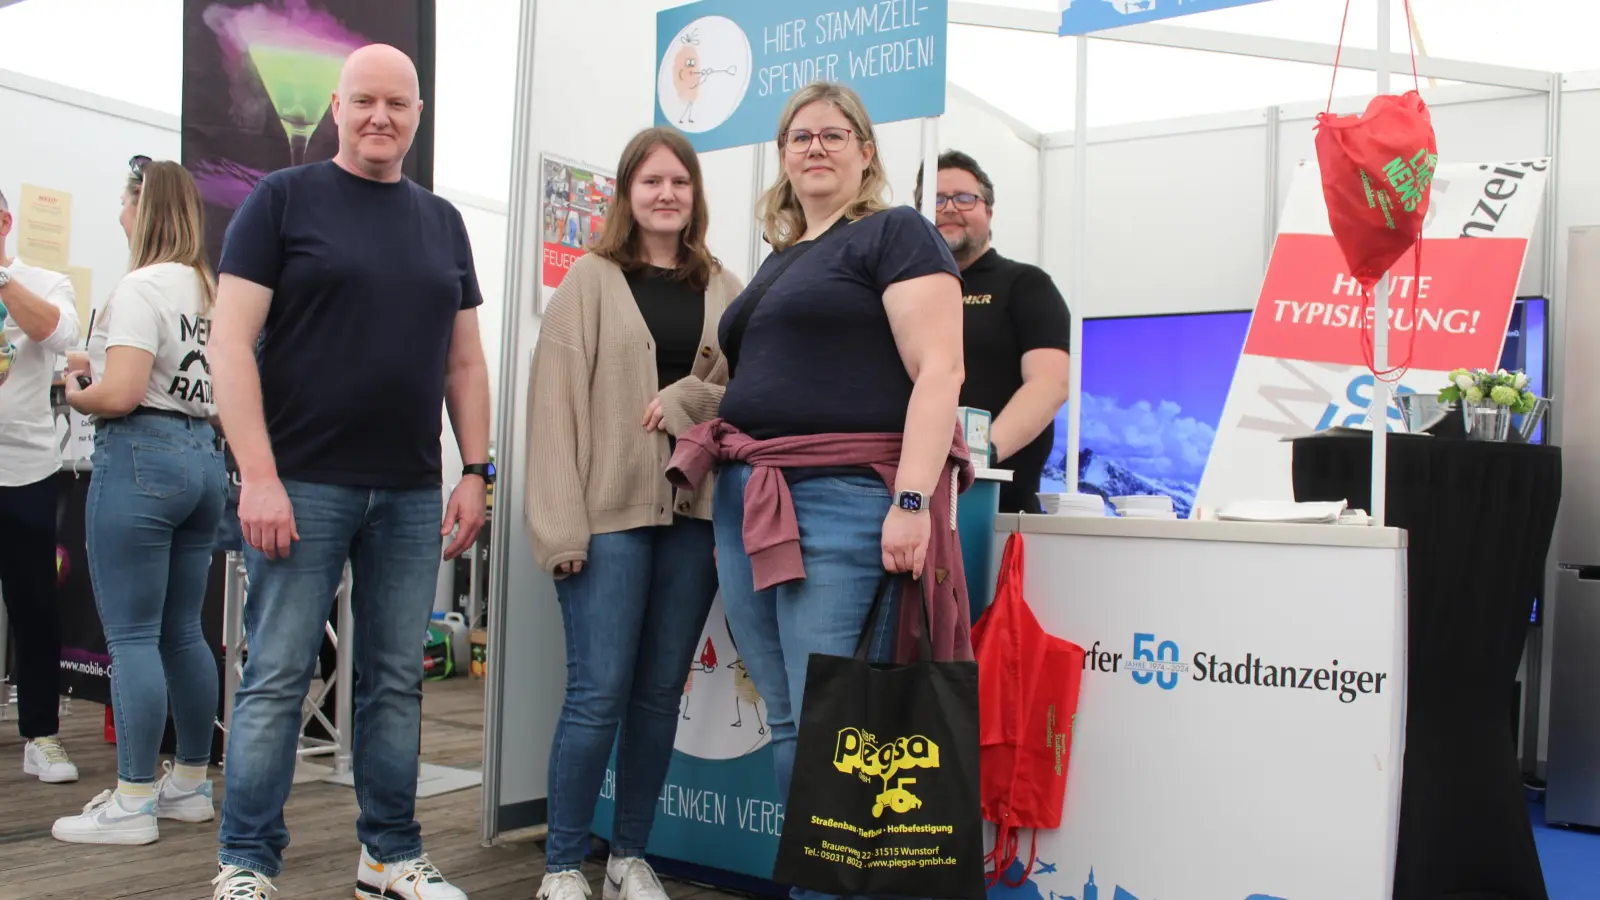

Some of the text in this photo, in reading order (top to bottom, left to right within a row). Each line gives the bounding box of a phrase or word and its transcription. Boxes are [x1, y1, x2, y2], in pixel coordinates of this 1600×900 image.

[764, 0, 929, 54] HIER STAMMZELL-
[758, 36, 934, 97] SPENDER WERDEN!
[1382, 156, 1423, 212] NEWS
[1131, 633, 1179, 690] 50
[1193, 652, 1387, 703] Stadtanzeiger
[811, 815, 857, 833] Straßenbau
[887, 823, 953, 834] Hofbefestigung
[822, 840, 940, 860] Brauerweg 22 31515 Wunstorf
[820, 851, 844, 862] 05031
[846, 856, 863, 869] 8022
[868, 857, 957, 869] www.piegsa-gmbh.de
